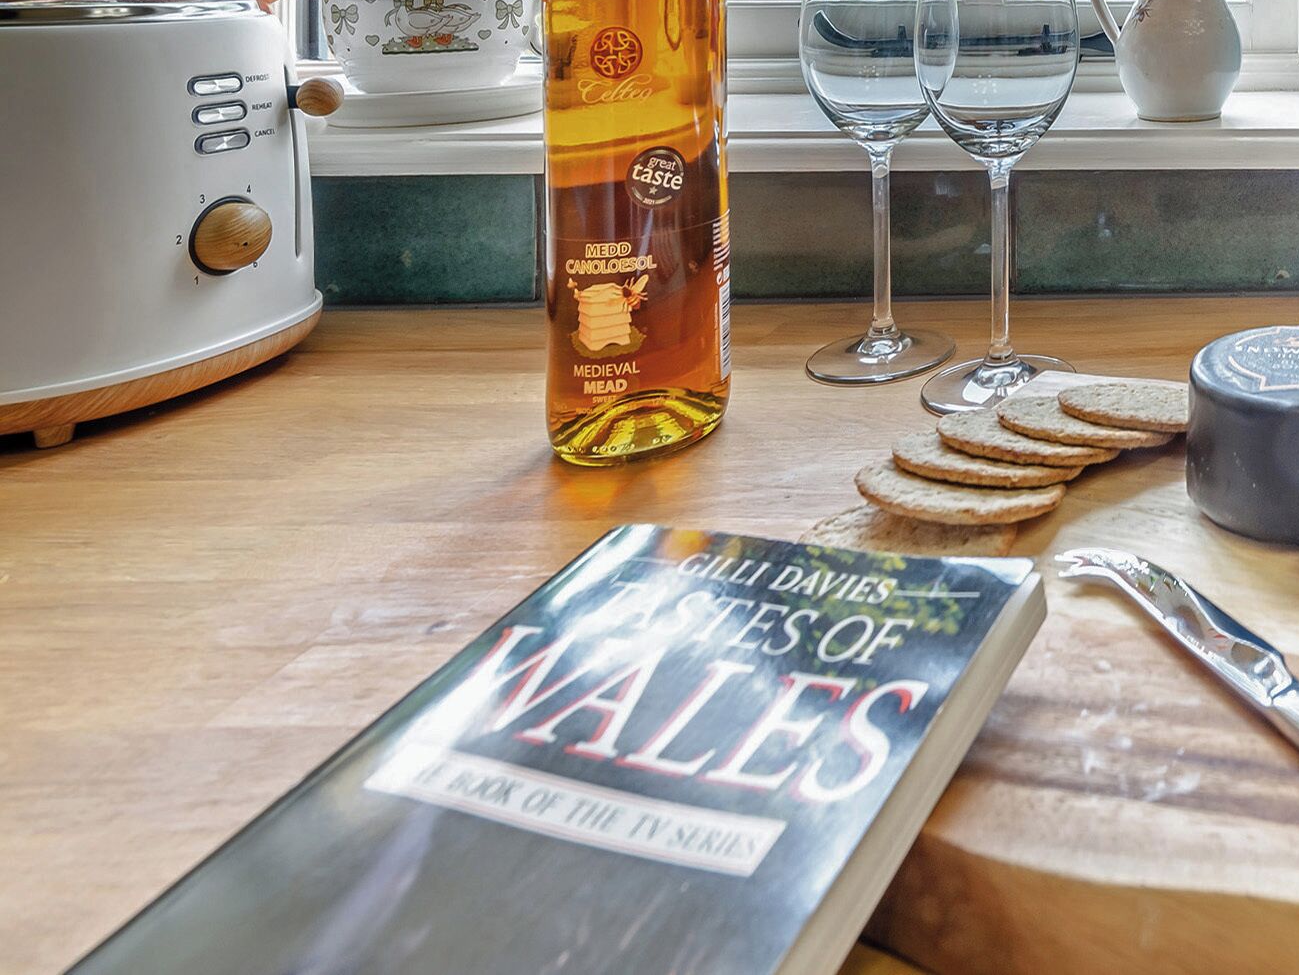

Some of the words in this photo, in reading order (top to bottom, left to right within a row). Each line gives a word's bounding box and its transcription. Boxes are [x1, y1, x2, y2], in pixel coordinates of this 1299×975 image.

[245, 73, 270, 83] DEFROST
[251, 101, 273, 111] REHEAT
[254, 128, 276, 138] CANCEL
[647, 157, 677, 171] great
[632, 162, 683, 190] taste
[246, 184, 252, 194] 4
[200, 194, 206, 204] 3
[176, 235, 183, 245] 2
[585, 241, 632, 258] MEDD
[565, 254, 657, 275] CANOLOESOL
[194, 276, 199, 285] 1
[573, 361, 640, 378] MEDIEVAL
[583, 378, 628, 395] MEAD
[677, 553, 770, 586] GILLI
[768, 566, 899, 605] DAVIES
[609, 574, 819, 657] TASTES
[816, 614, 915, 666] OF
[470, 623, 929, 804] WALES
[446, 769, 524, 806] BOOK
[521, 787, 565, 817] OF
[564, 795, 628, 833] THE
[629, 811, 673, 842] TV
[667, 823, 764, 860] SERIES
